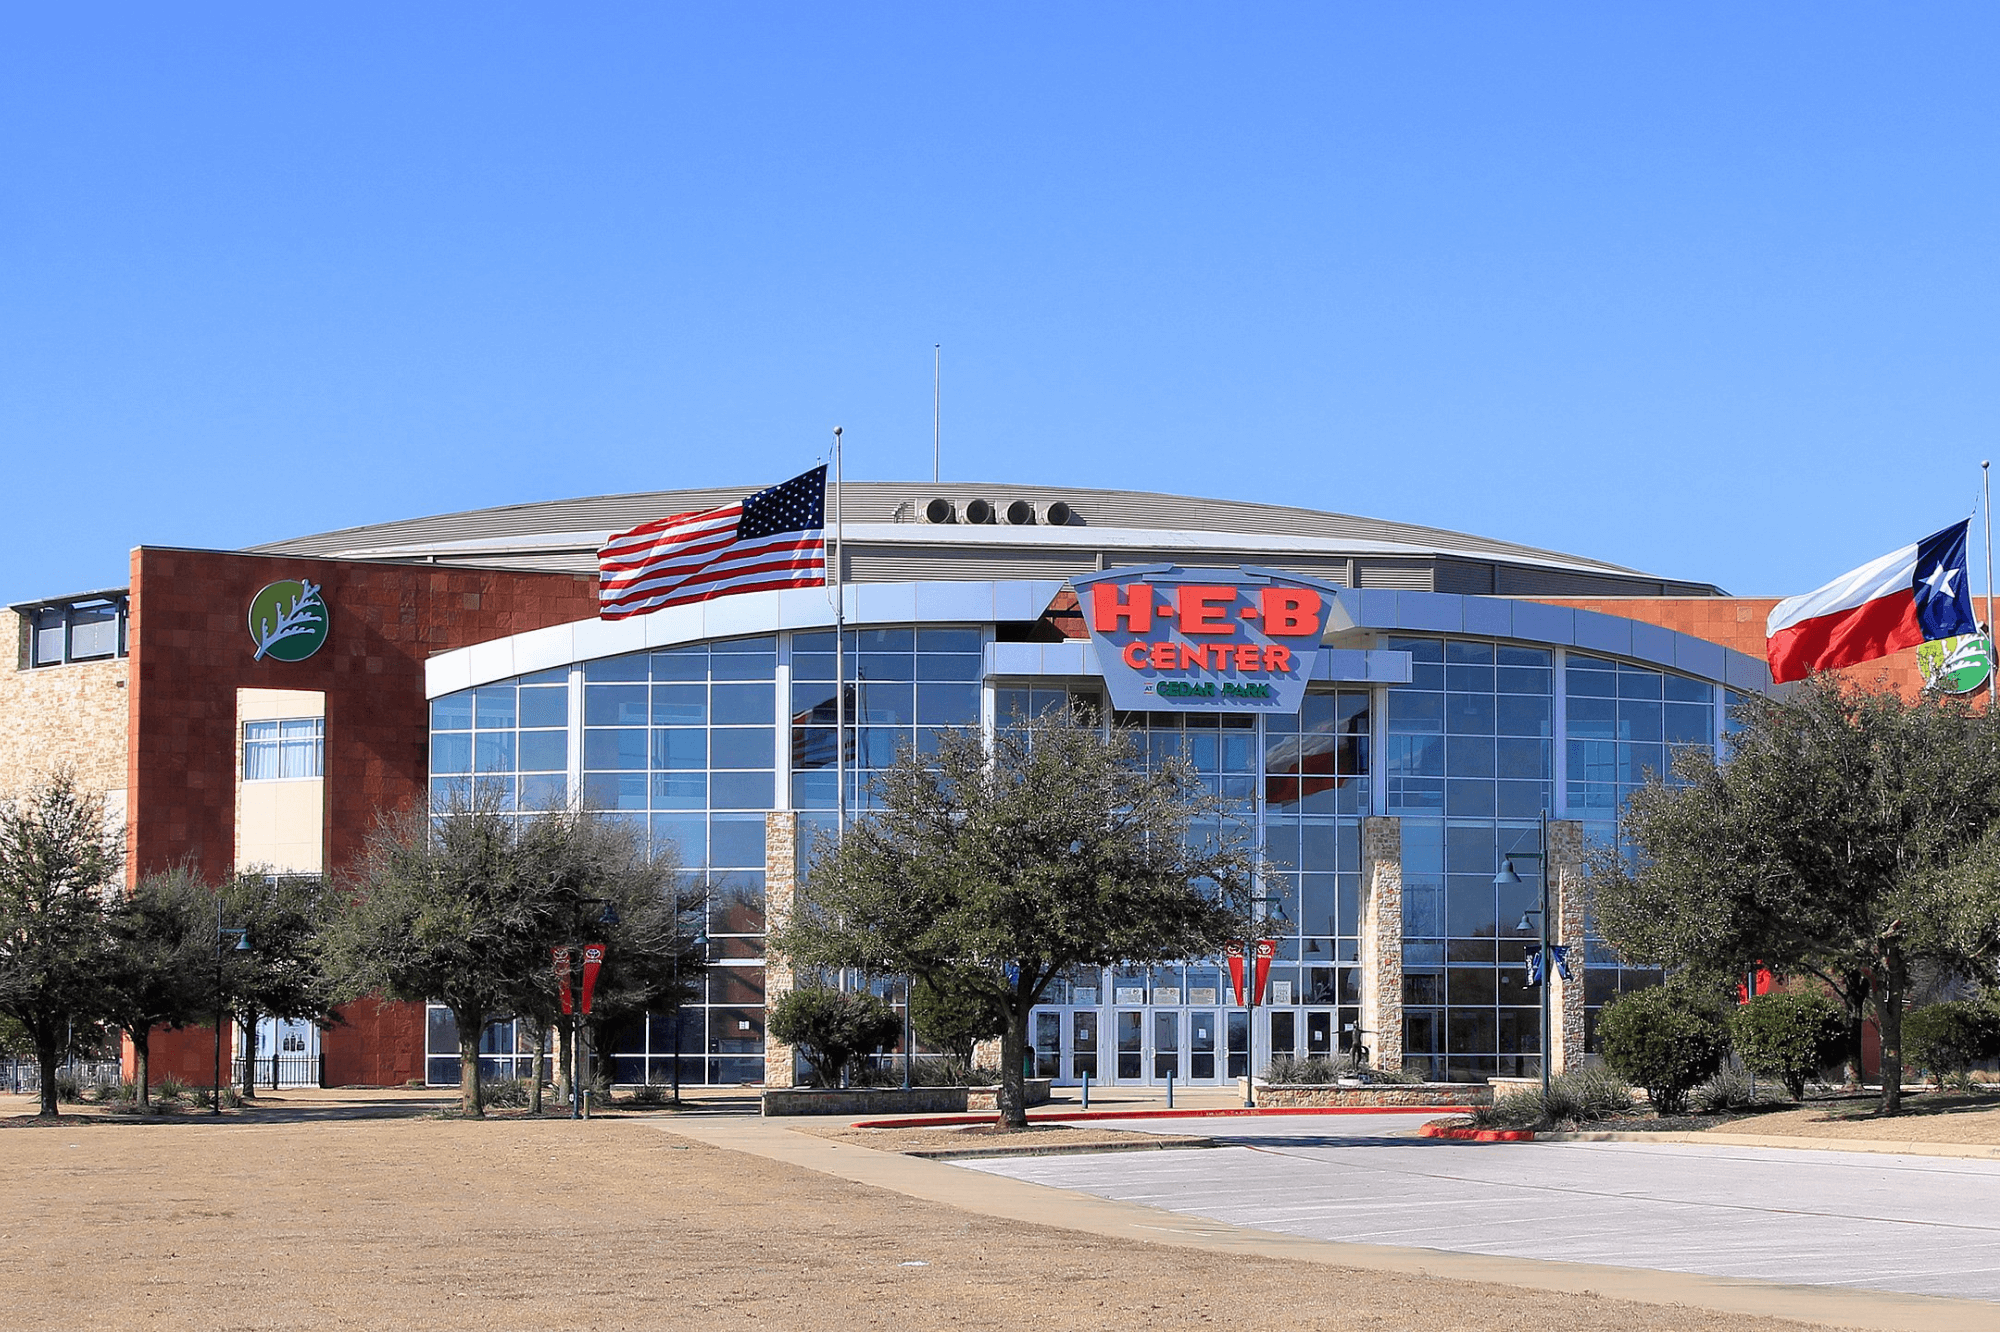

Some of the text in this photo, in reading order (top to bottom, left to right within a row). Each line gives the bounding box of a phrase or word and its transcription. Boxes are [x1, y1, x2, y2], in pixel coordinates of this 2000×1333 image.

[1123, 641, 1291, 672] CENTER
[1156, 681, 1216, 698] CEDAR
[1221, 682, 1271, 699] PARK
